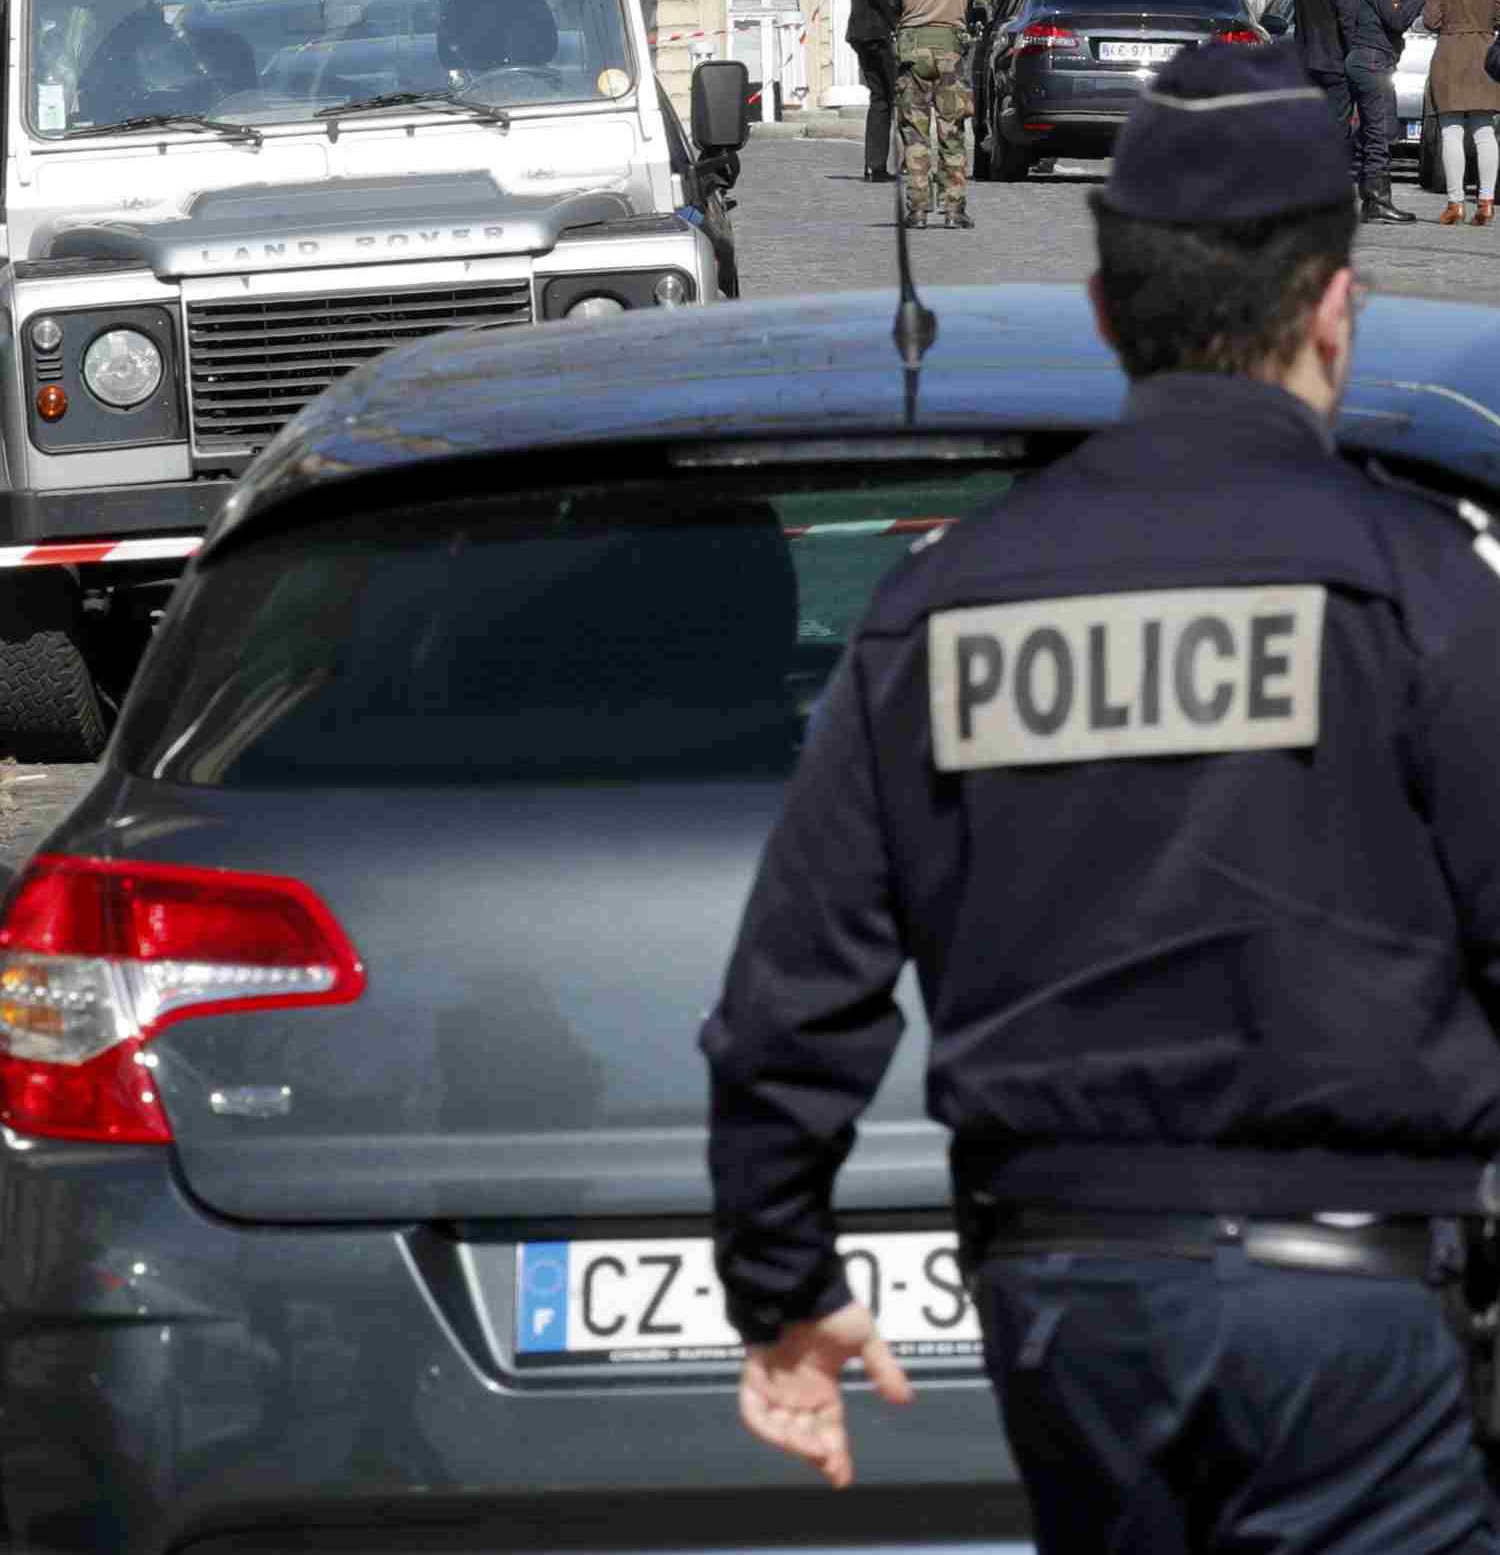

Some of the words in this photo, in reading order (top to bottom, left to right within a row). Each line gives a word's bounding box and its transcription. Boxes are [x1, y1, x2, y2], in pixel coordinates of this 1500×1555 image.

[202, 241, 319, 261] LAND
[355, 226, 504, 248] ROVER
[955, 613, 1296, 740] POLICE
